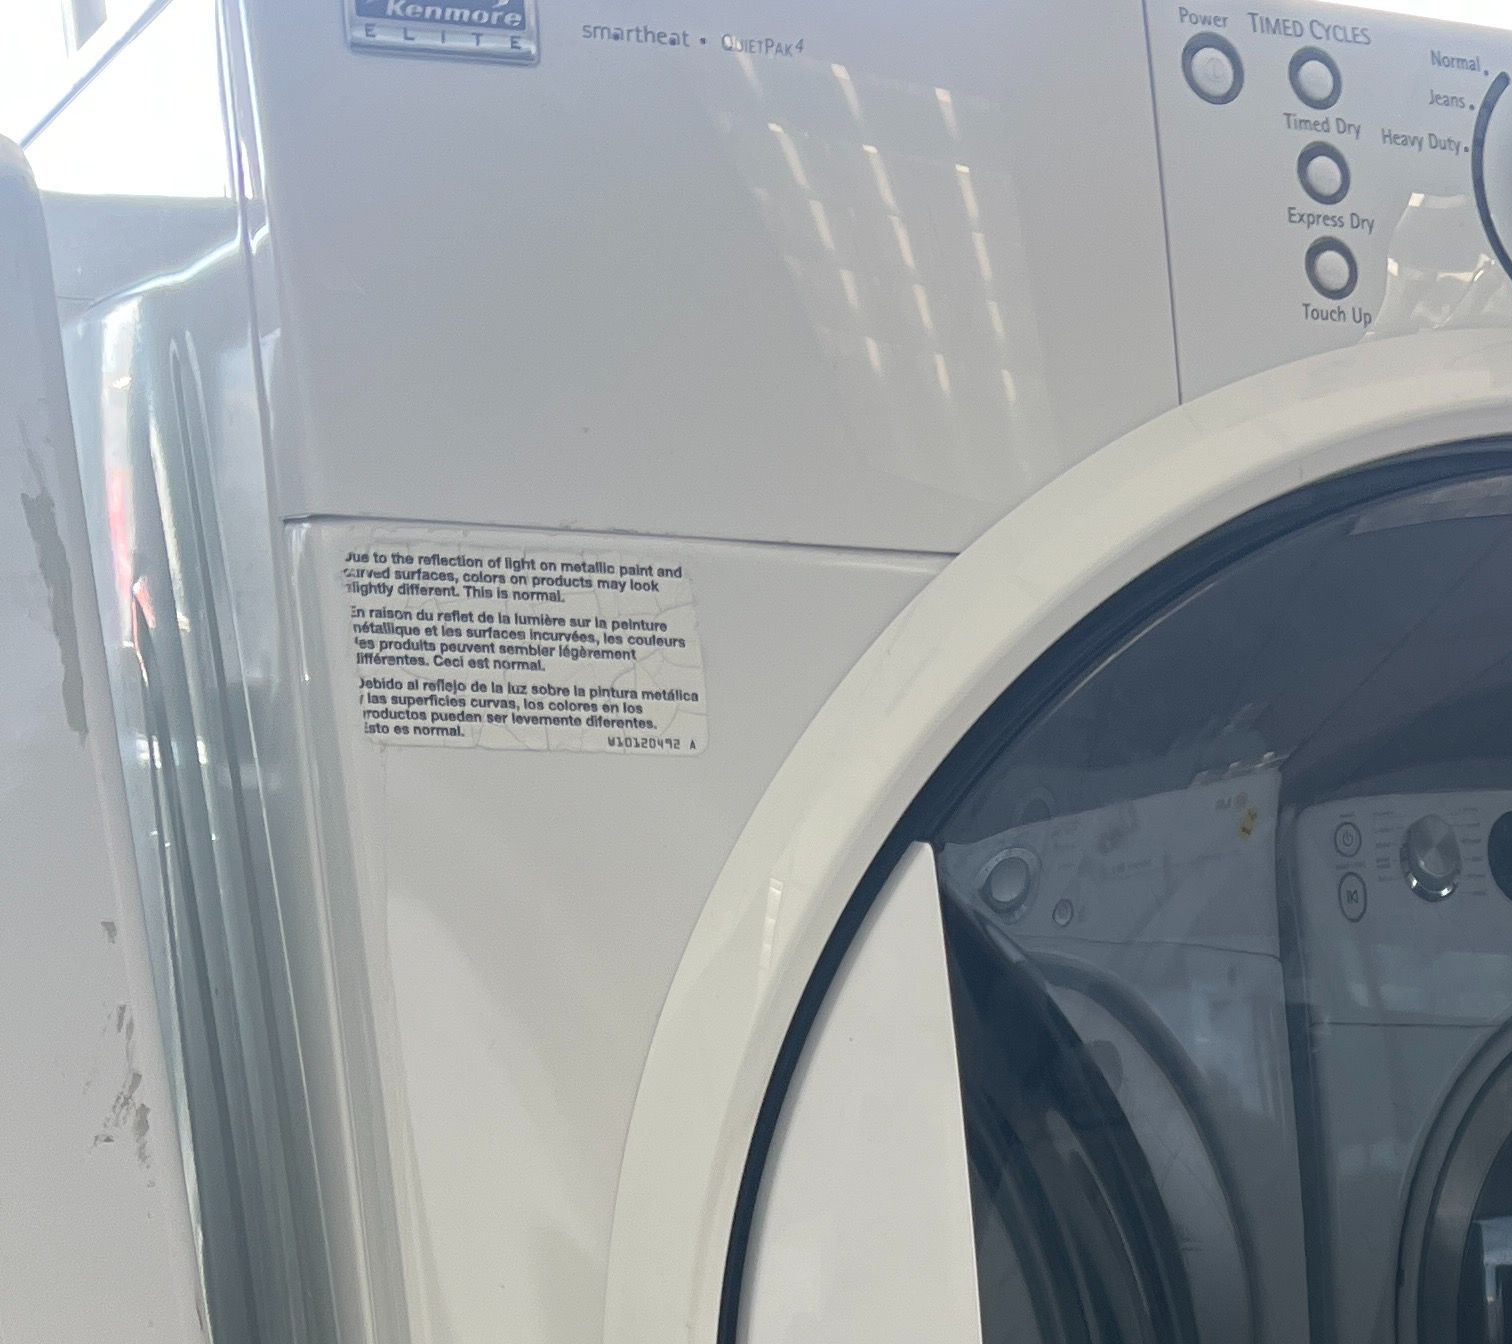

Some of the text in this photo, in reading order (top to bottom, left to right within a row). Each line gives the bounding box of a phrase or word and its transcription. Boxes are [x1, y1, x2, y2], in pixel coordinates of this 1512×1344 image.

[386, 0, 522, 27] Kenmore
[1178, 7, 1228, 29] Power
[582, 24, 690, 47] smartheat
[1248, 12, 1371, 45] TIMED CYCLES
[1430, 50, 1480, 72] Normal
[1429, 89, 1465, 108] Jeans
[1283, 113, 1361, 140] Timed Dry
[1381, 128, 1461, 156] Heavy Duty
[1287, 208, 1375, 234] Express Dry
[1302, 304, 1372, 327] Touch Up
[373, 552, 386, 563] to
[391, 552, 413, 564] the
[418, 553, 483, 568] reflection
[488, 556, 501, 569] of
[505, 557, 535, 572] light
[540, 561, 556, 571] on
[561, 561, 614, 574] metallic
[620, 564, 653, 577] paint
[657, 566, 682, 578] and
[394, 568, 458, 583] surfaces,
[463, 572, 505, 583] colors
[510, 575, 527, 585] on
[533, 576, 592, 588] products
[597, 581, 626, 592] may
[630, 579, 659, 592] look
[398, 585, 459, 597] different.
[463, 586, 492, 598] This
[497, 587, 508, 599] is
[512, 590, 565, 602] normal.
[689, 740, 696, 749] A
